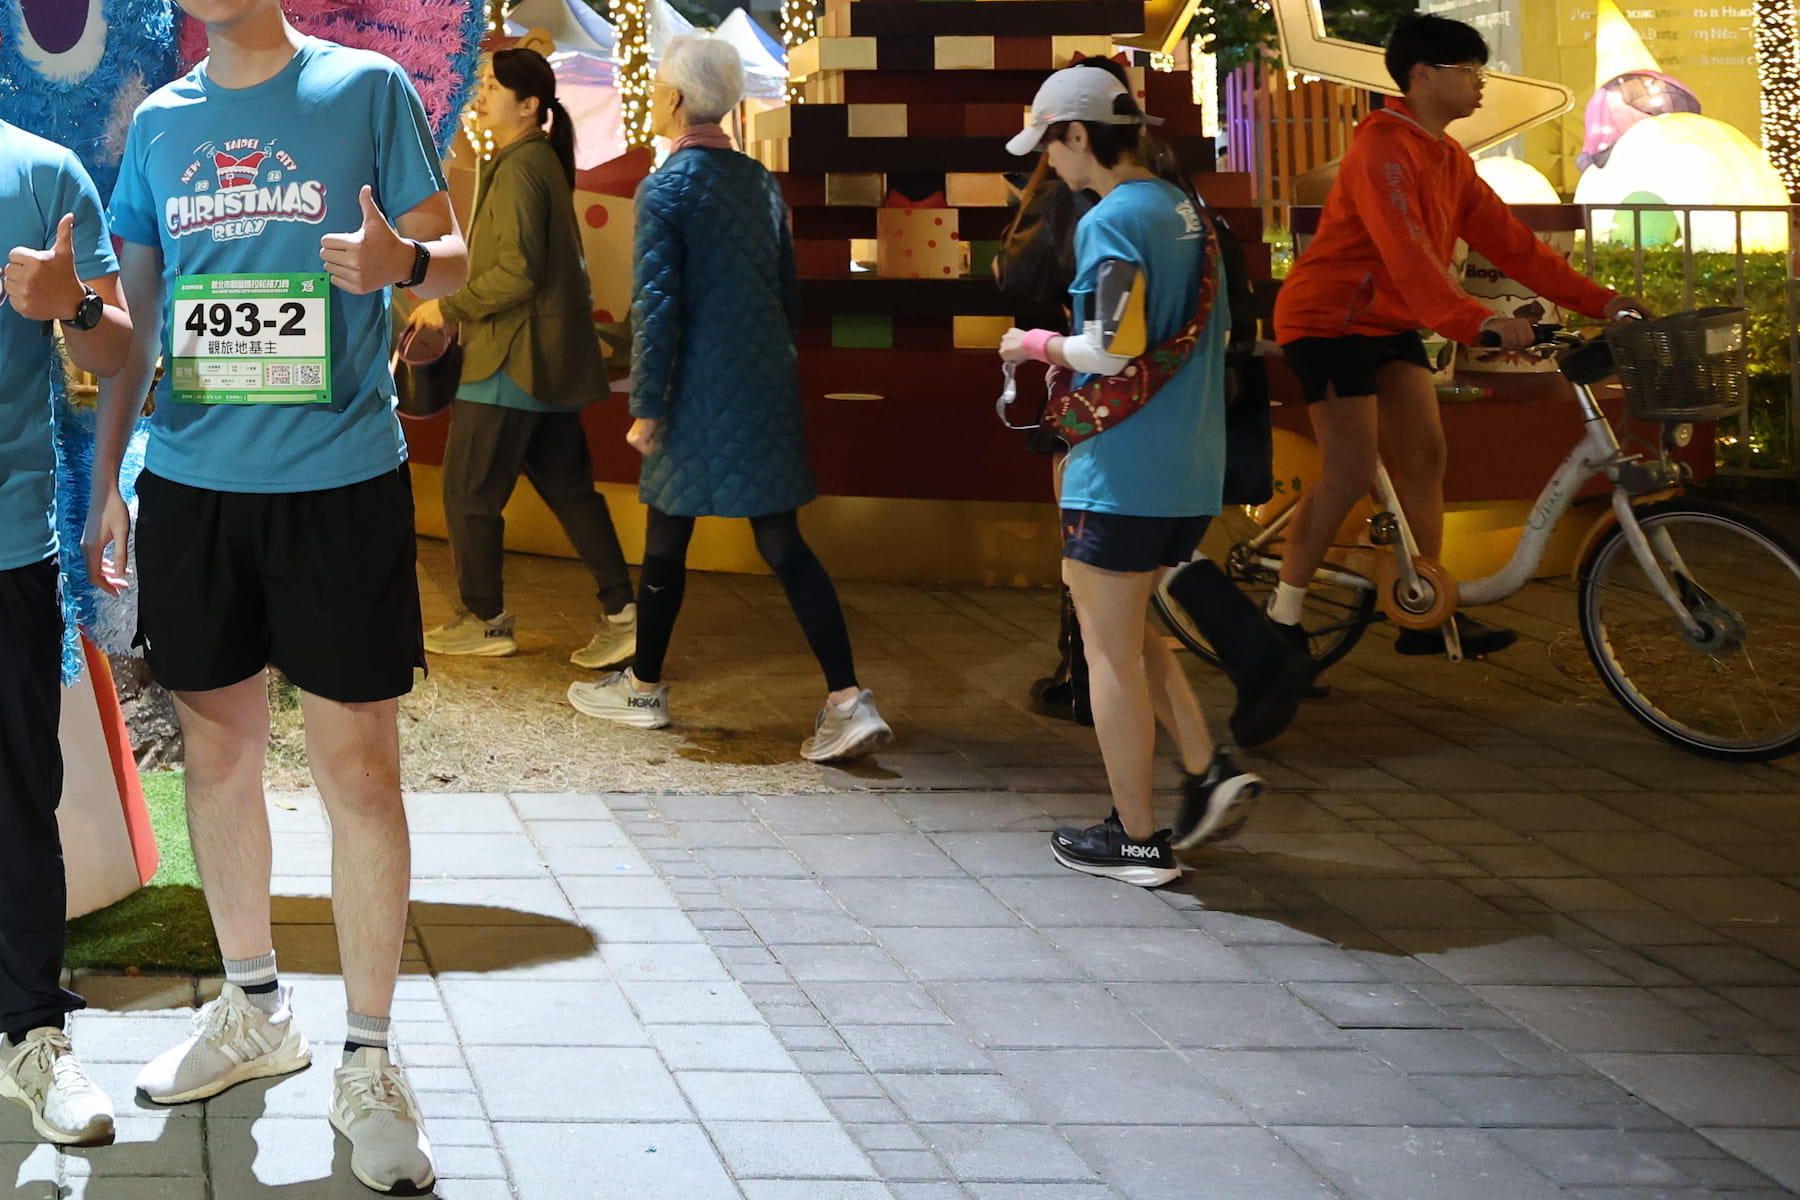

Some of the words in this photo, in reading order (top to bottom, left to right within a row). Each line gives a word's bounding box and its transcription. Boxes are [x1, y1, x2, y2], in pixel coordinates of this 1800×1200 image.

[180, 160, 202, 184] NEW
[224, 138, 259, 151] TAIPEI
[275, 150, 298, 171] CITY
[166, 180, 322, 232] CHRISTMAS
[214, 220, 265, 238] RELAY
[185, 302, 306, 337] 493-2
[208, 340, 277, 355] 觀旅地基主
[627, 697, 661, 708] HOKA
[1121, 844, 1161, 859] HOKA
